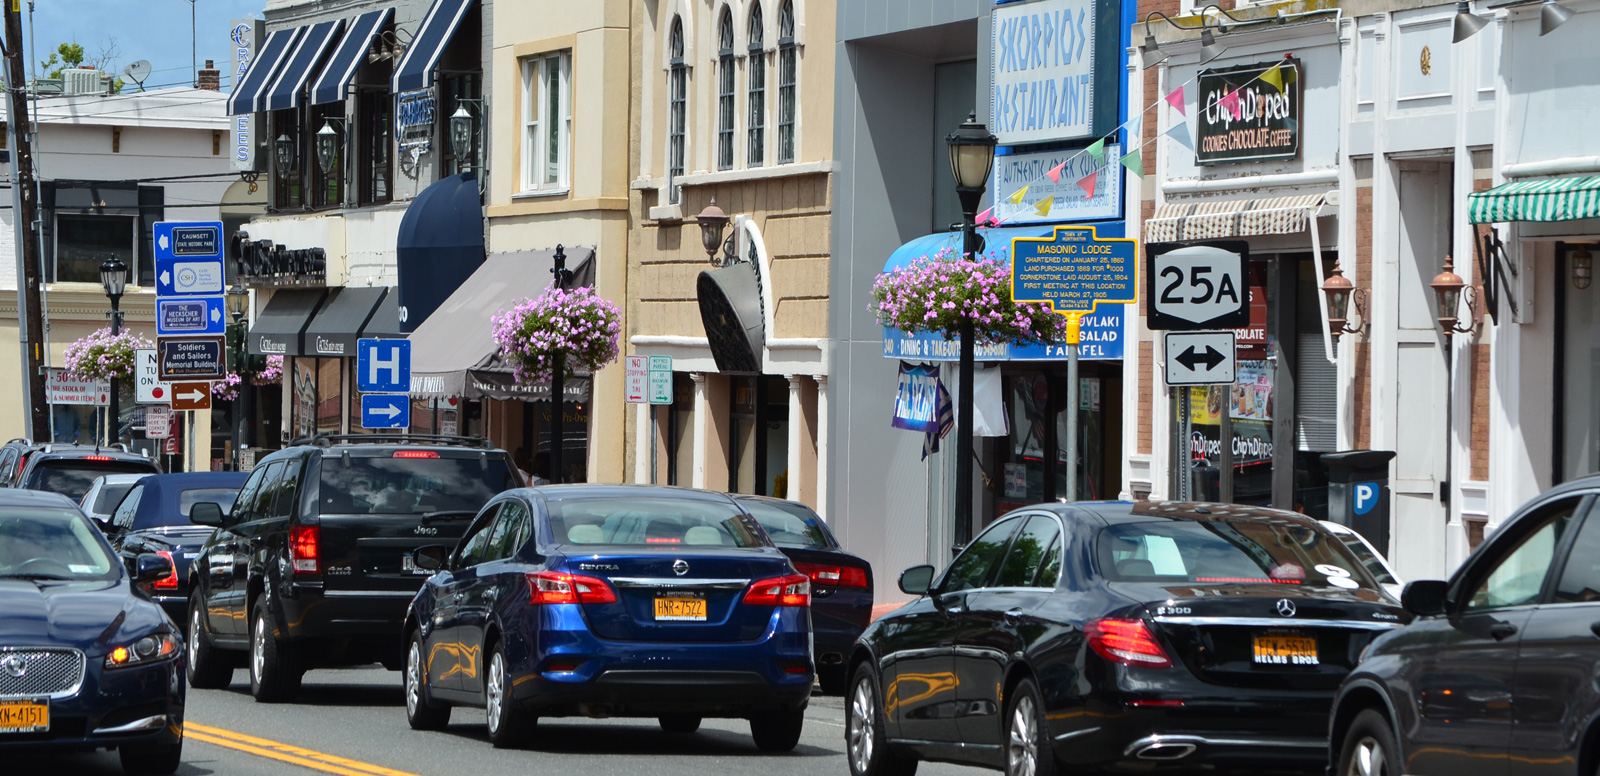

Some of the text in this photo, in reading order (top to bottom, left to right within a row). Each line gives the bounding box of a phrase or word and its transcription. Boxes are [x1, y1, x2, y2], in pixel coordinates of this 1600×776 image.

[999, 5, 1086, 72] SKORPIOS
[1202, 128, 1292, 152] COOKIES CHOCOLATE COFFEE
[1004, 160, 1045, 183] AUTHENTIC
[1037, 245, 1112, 254] MASONIC LODGE
[1160, 266, 1238, 304] 25A
[1080, 316, 1119, 327] UVLAKI
[1079, 331, 1117, 342] SALAD
[1236, 329, 1264, 340] COLATE
[884, 339, 894, 353] 340
[900, 339, 920, 355] DINING
[924, 340, 928, 355] &
[1046, 345, 1104, 356] FAFEL
[194, 360, 216, 369] Building
[369, 347, 399, 384] H
[632, 359, 640, 367] NO
[141, 377, 153, 385] ON
[563, 412, 587, 423] Pre-Own
[1356, 485, 1372, 509] P
[414, 526, 438, 536] Jeep
[1255, 655, 1320, 664] HELMS BROS.
